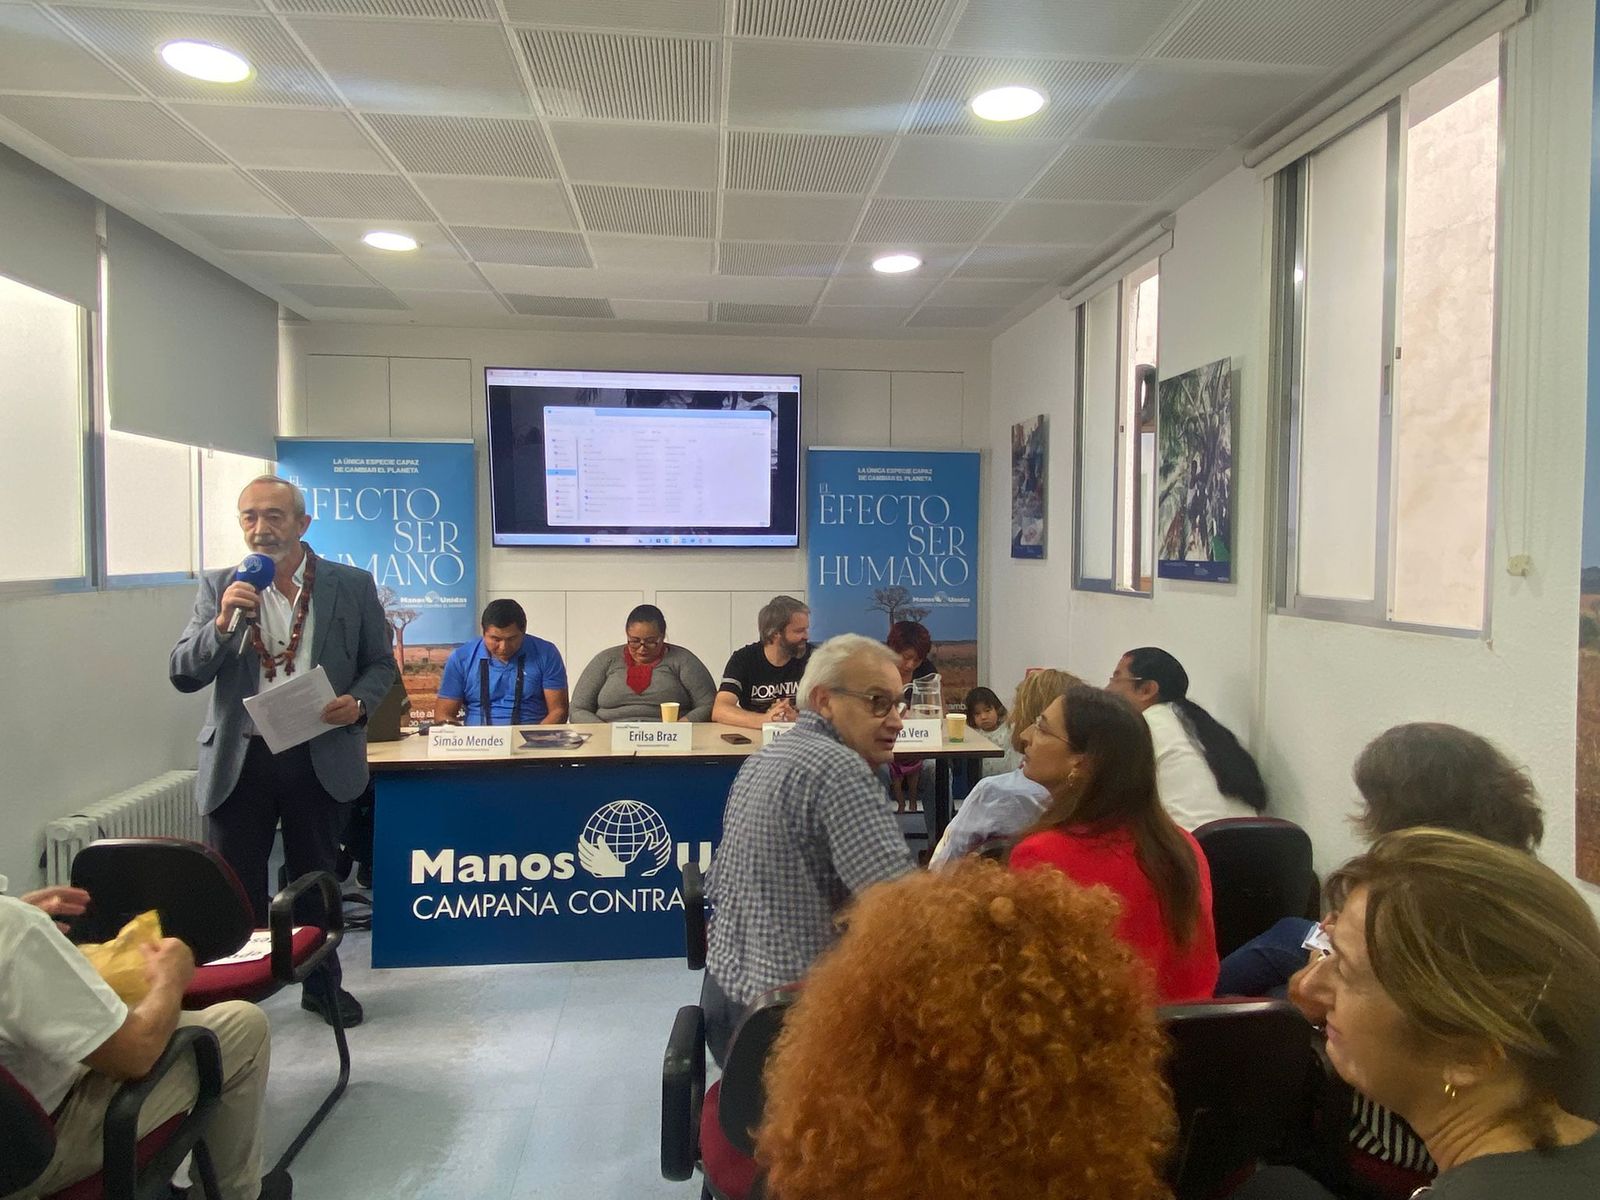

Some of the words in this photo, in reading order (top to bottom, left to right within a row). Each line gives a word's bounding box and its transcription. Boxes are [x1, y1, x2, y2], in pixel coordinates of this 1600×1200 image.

[299, 487, 441, 521] FECTO
[819, 494, 950, 526] EFECTO
[393, 521, 462, 554] SER
[908, 525, 967, 556] SER
[819, 555, 969, 587] HUMANO
[433, 735, 464, 747] Simão
[466, 735, 504, 747] Mendes
[629, 730, 654, 741] Erilsa
[656, 730, 678, 741] Braz
[908, 728, 929, 738] Vera
[411, 848, 575, 884] Manos
[412, 886, 560, 920] CAMPAÑA
[568, 887, 685, 915] CONTRA
